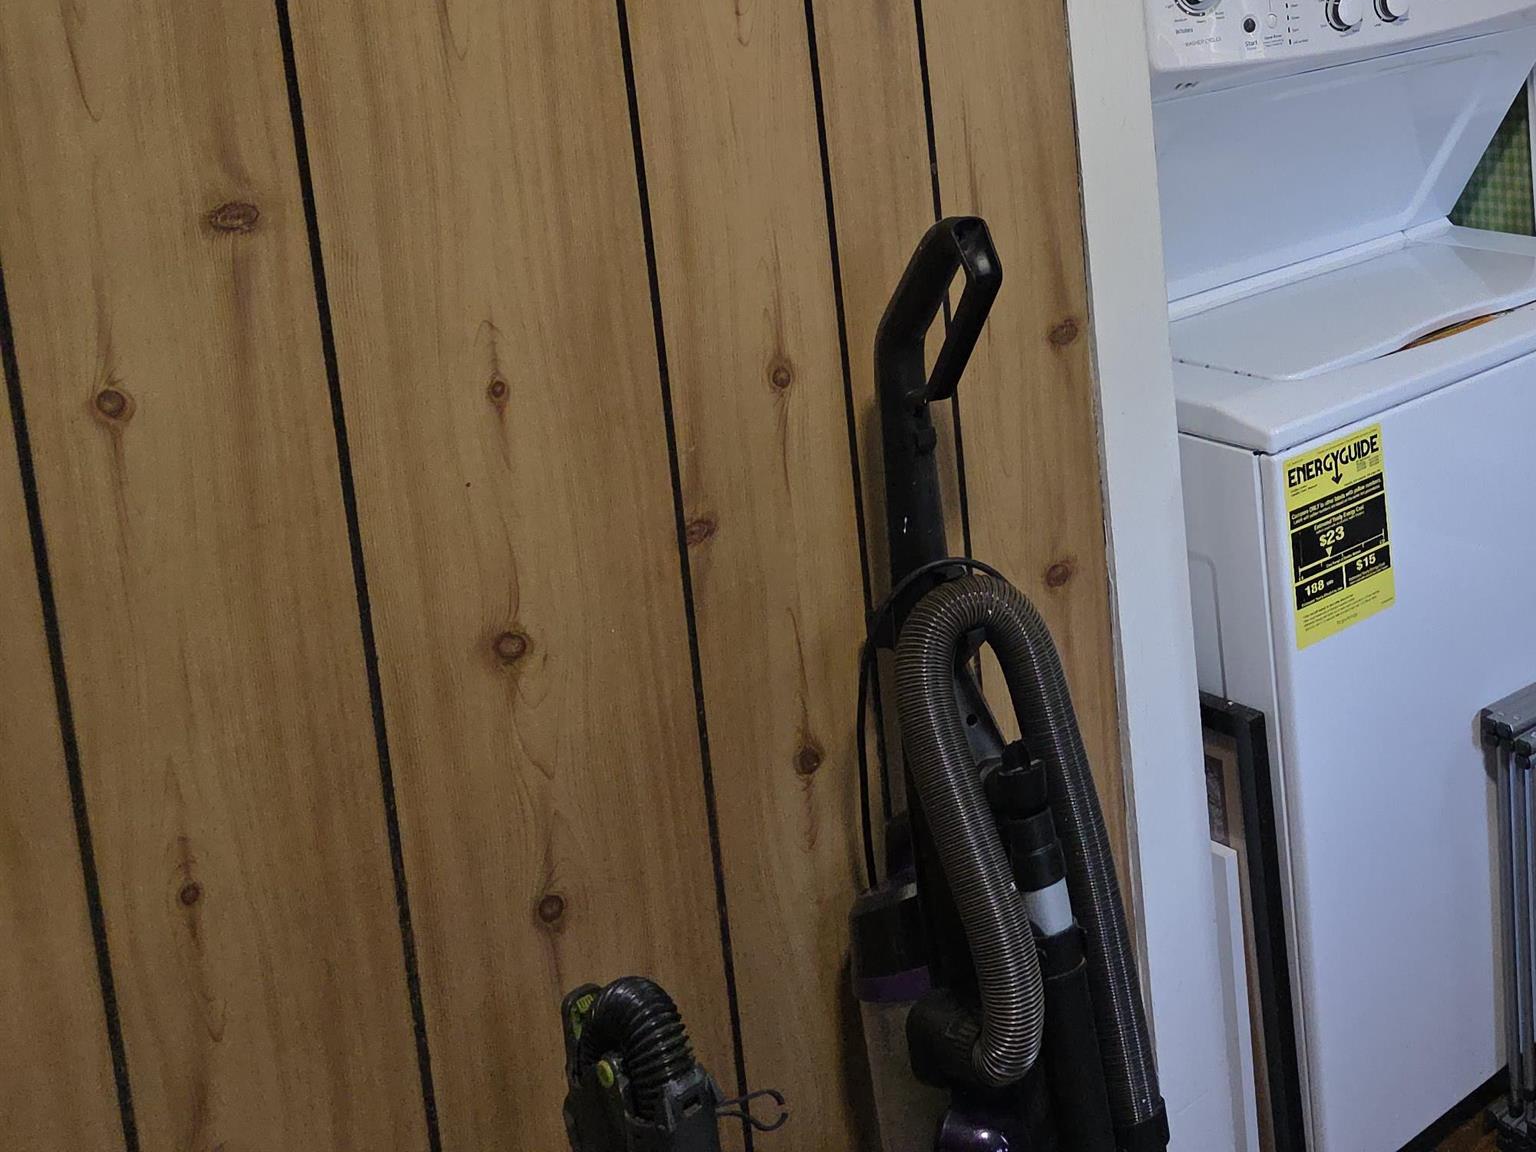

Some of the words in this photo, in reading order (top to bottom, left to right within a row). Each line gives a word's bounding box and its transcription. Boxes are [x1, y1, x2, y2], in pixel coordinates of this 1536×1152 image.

[1288, 434, 1379, 488] ENERGYGUIDE
[1319, 526, 1345, 547] $23
[1356, 553, 1376, 571] $15
[1304, 579, 1325, 596] 188
